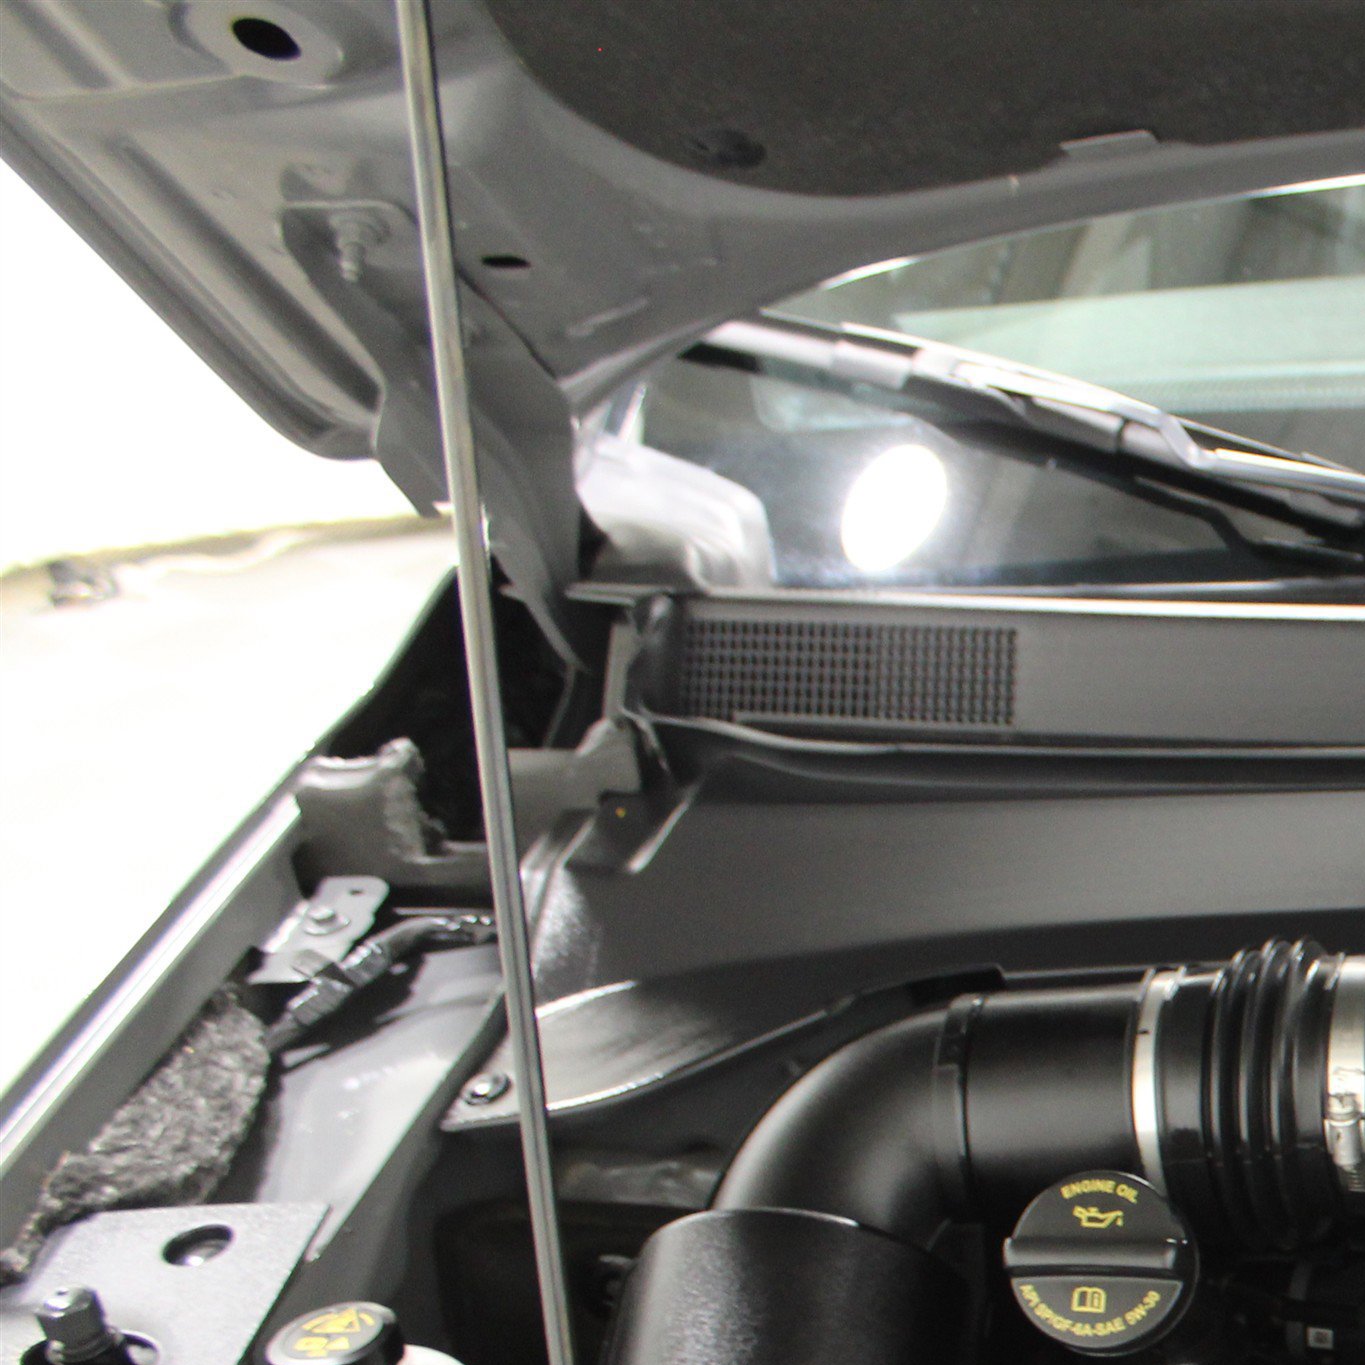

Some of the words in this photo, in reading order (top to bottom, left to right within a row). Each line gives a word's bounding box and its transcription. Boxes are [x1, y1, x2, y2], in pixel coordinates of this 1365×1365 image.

[1060, 1179, 1116, 1200] ENGINE
[1115, 1182, 1140, 1204] OIL
[1019, 1284, 1040, 1307] API
